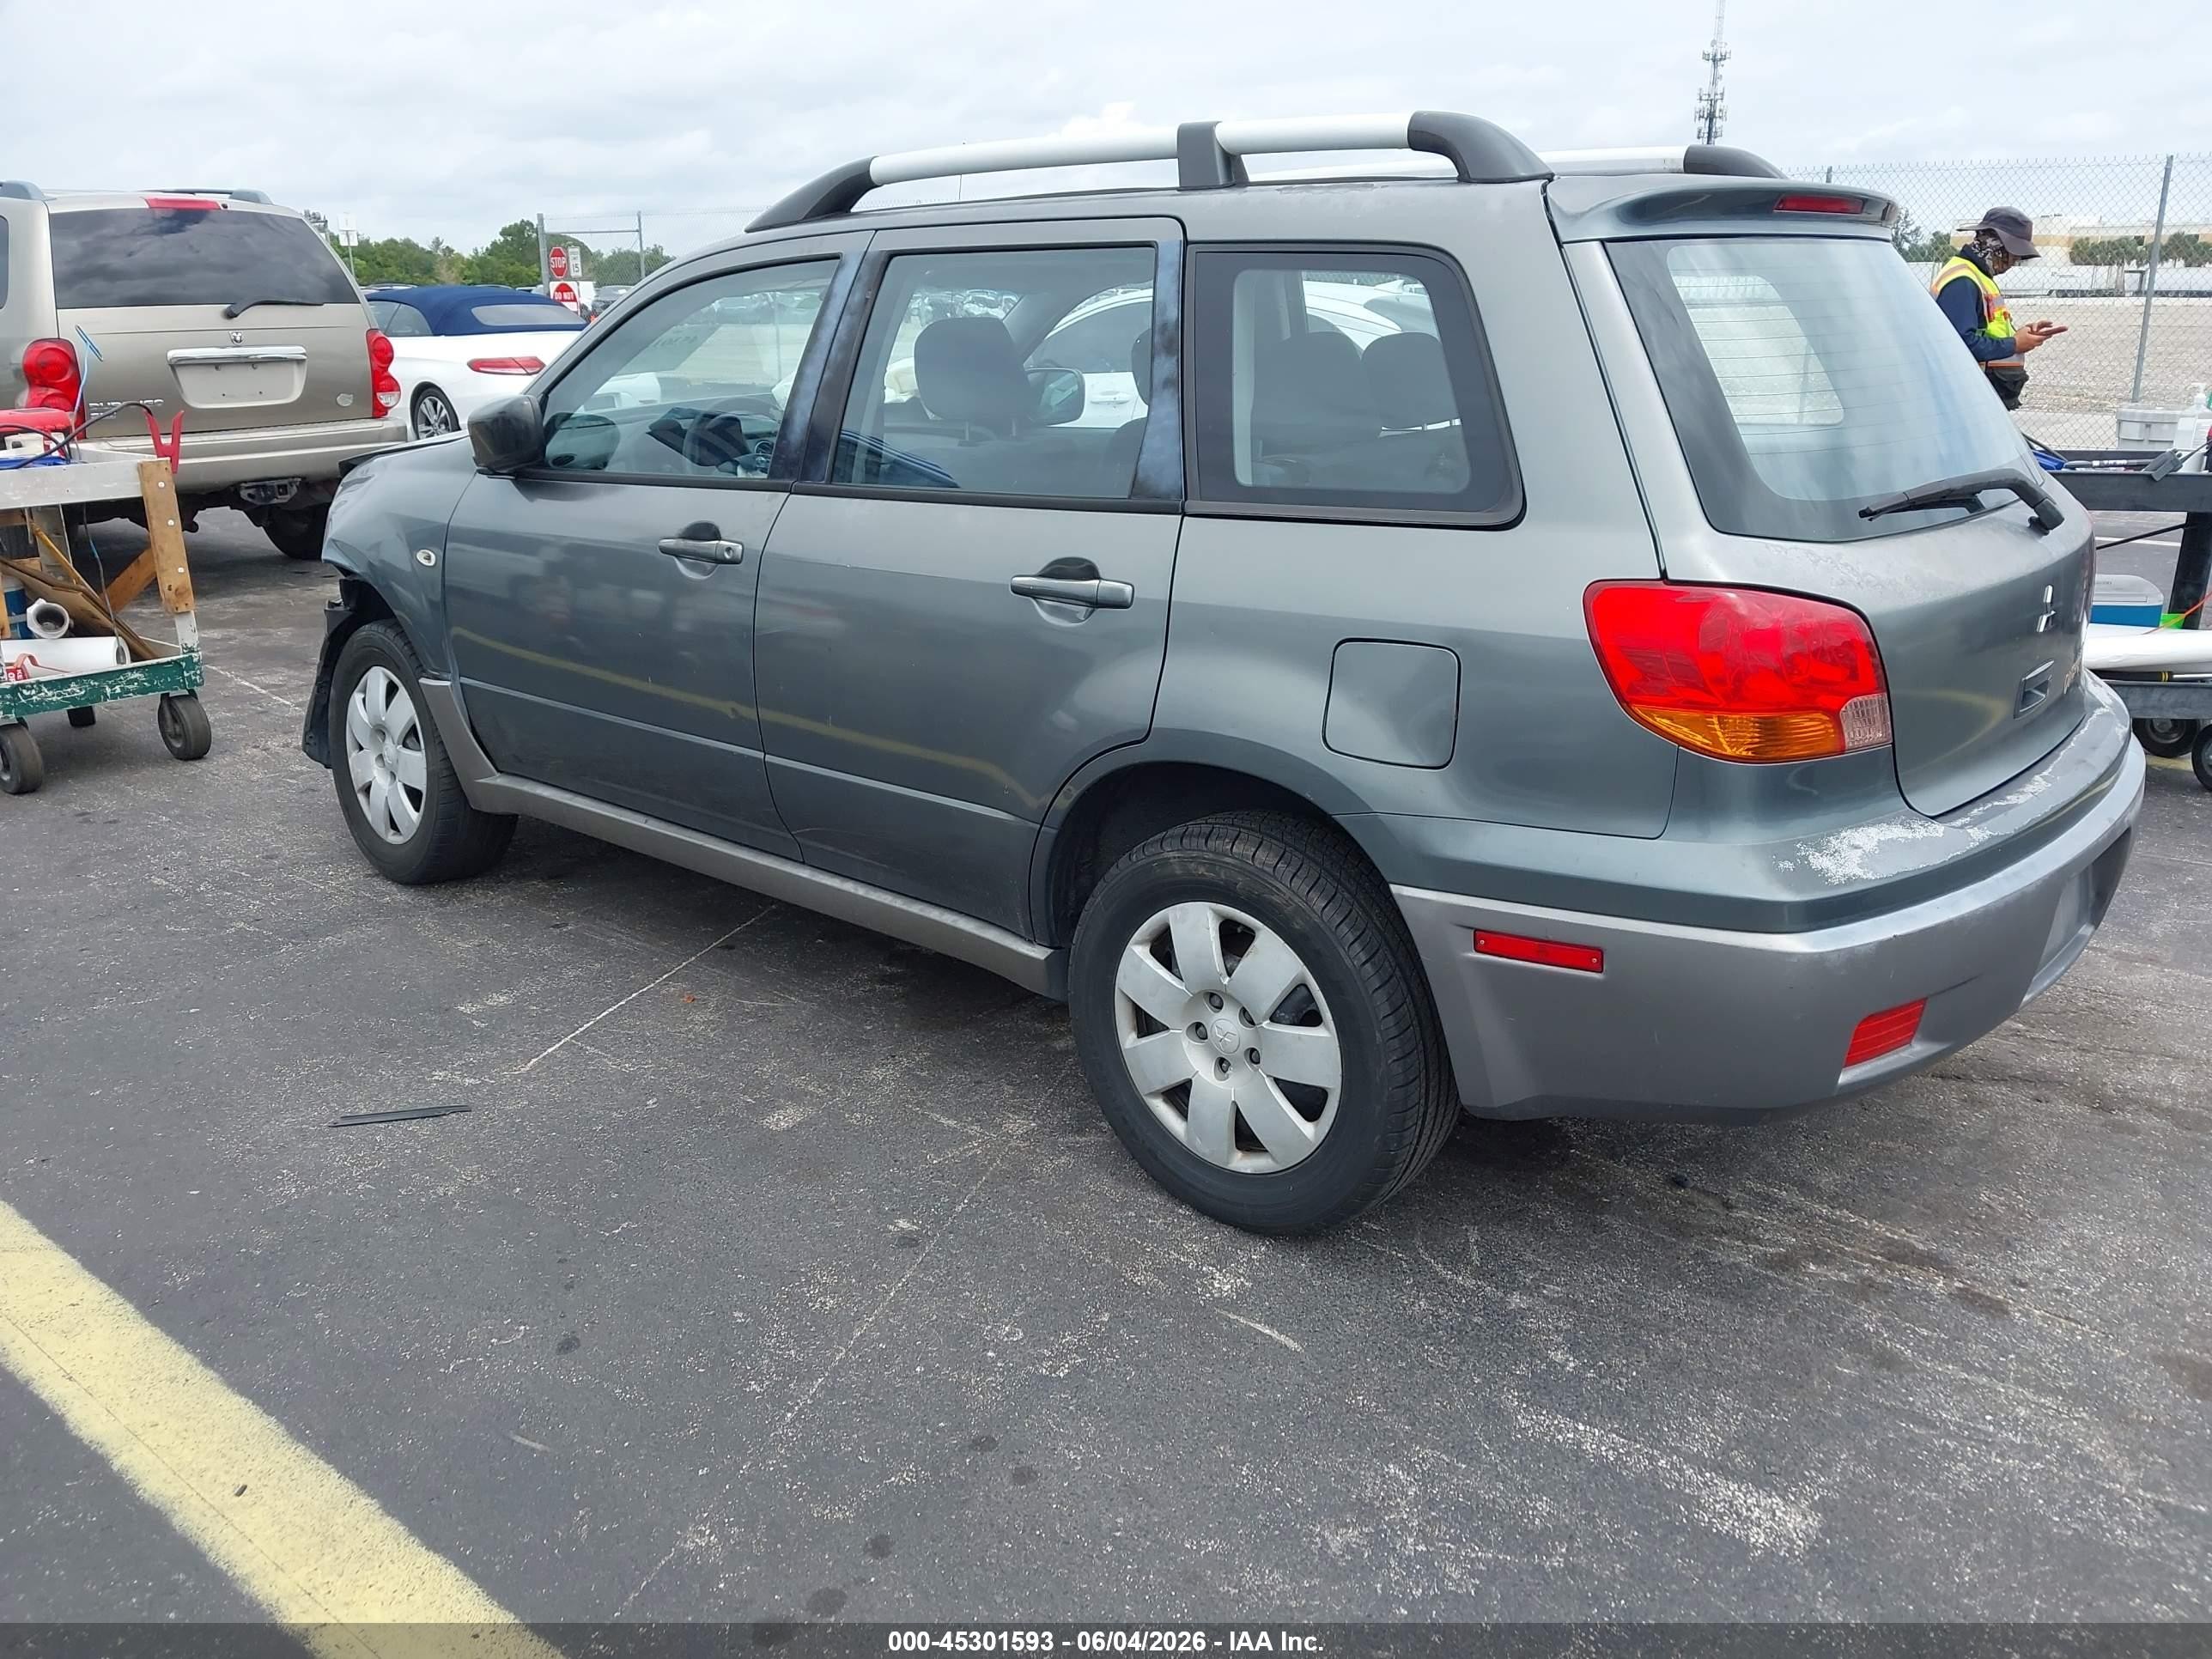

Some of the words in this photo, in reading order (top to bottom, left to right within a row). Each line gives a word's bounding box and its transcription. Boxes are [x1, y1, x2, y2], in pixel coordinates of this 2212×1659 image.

[550, 257, 566, 269] STOP
[572, 263, 580, 273] 15
[554, 291, 562, 300] DO
[563, 291, 574, 300] NOT
